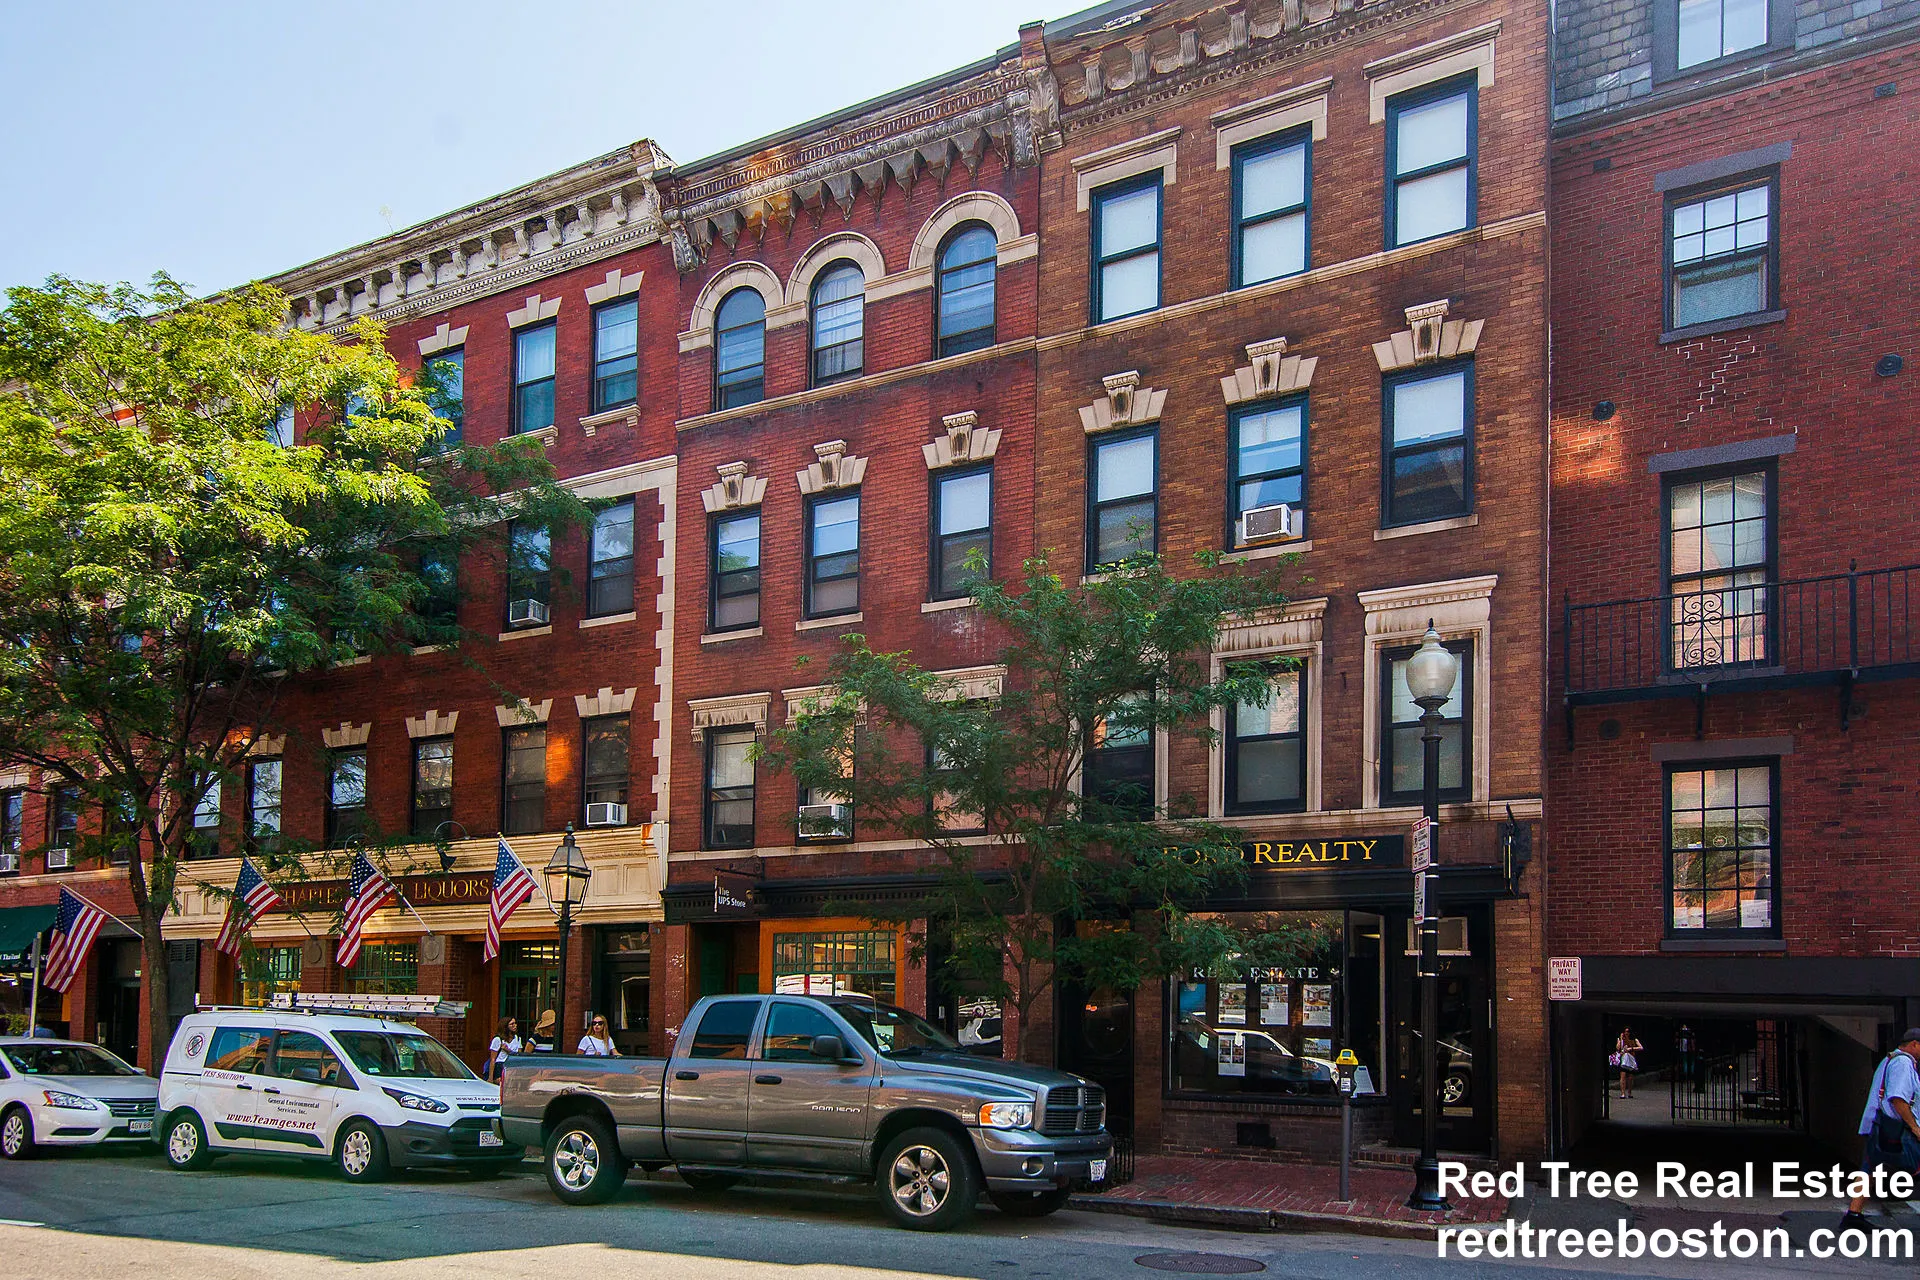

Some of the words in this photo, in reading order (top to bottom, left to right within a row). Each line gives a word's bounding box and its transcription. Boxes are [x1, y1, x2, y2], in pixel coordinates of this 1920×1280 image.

[1253, 840, 1377, 864] REALTY
[414, 878, 489, 900] LIQUORS
[718, 887, 730, 896] The
[718, 896, 731, 906] UPS
[731, 898, 746, 908] Store
[203, 1070, 216, 1078] PEST
[216, 1072, 246, 1081] SOLUTIONS
[267, 1097, 286, 1105] General
[286, 1099, 320, 1109] Environmental
[226, 1113, 317, 1130] www.Teamges.net
